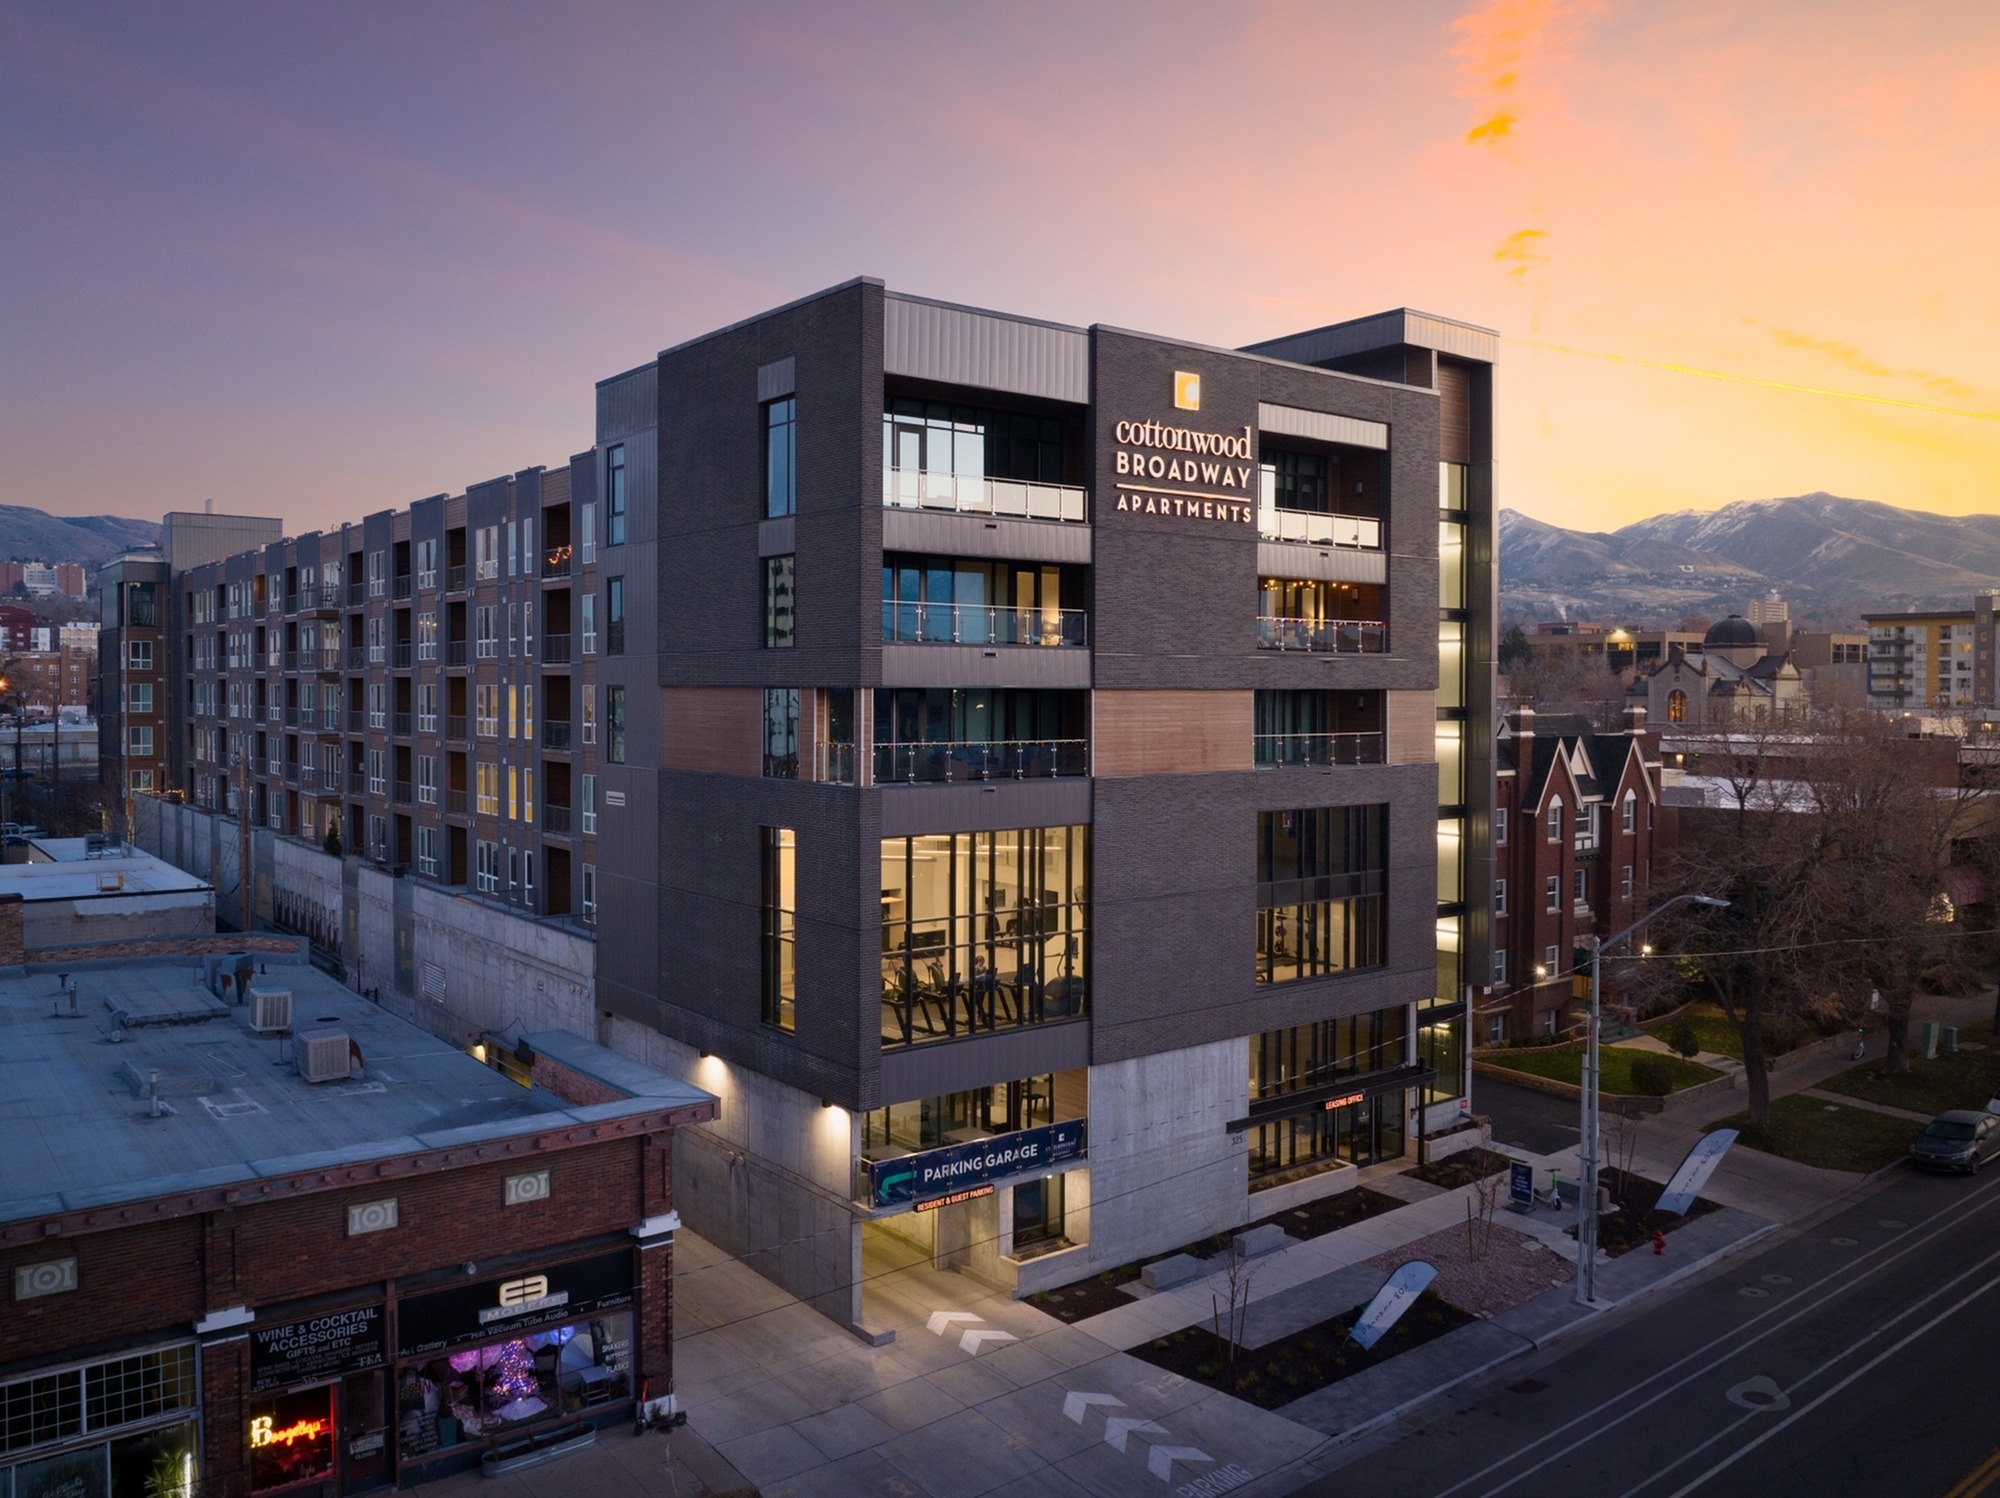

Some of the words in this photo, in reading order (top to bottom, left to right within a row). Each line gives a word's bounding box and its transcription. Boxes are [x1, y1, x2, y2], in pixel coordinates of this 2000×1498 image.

[1116, 419, 1252, 460] cottonwood
[1117, 451, 1251, 489] BROADWAY
[1117, 494, 1251, 523] APARTMENTS
[1326, 1098, 1347, 1110] LEASING
[1347, 1094, 1363, 1104] OFFICE
[924, 1157, 983, 1182] PARKING
[985, 1144, 1038, 1168] GARAGE
[917, 1197, 945, 1212] RESIDENT
[945, 1196, 951, 1205] &
[951, 1192, 969, 1203] GUEST
[969, 1186, 994, 1198] PARKING
[257, 1325, 295, 1344] WINE
[297, 1324, 307, 1335] &
[309, 1308, 378, 1332] COCKTAIL
[487, 1322, 522, 1337] Vacuum
[523, 1316, 543, 1328] Tube
[545, 1309, 569, 1322] Audio
[596, 1294, 632, 1309] Furniture
[268, 1321, 368, 1354] ACCESSORIES
[286, 1345, 316, 1359] GIFTS
[331, 1337, 352, 1350] ETC
[602, 1339, 629, 1353] SHAKERS
[606, 1361, 629, 1374] FLASKS
